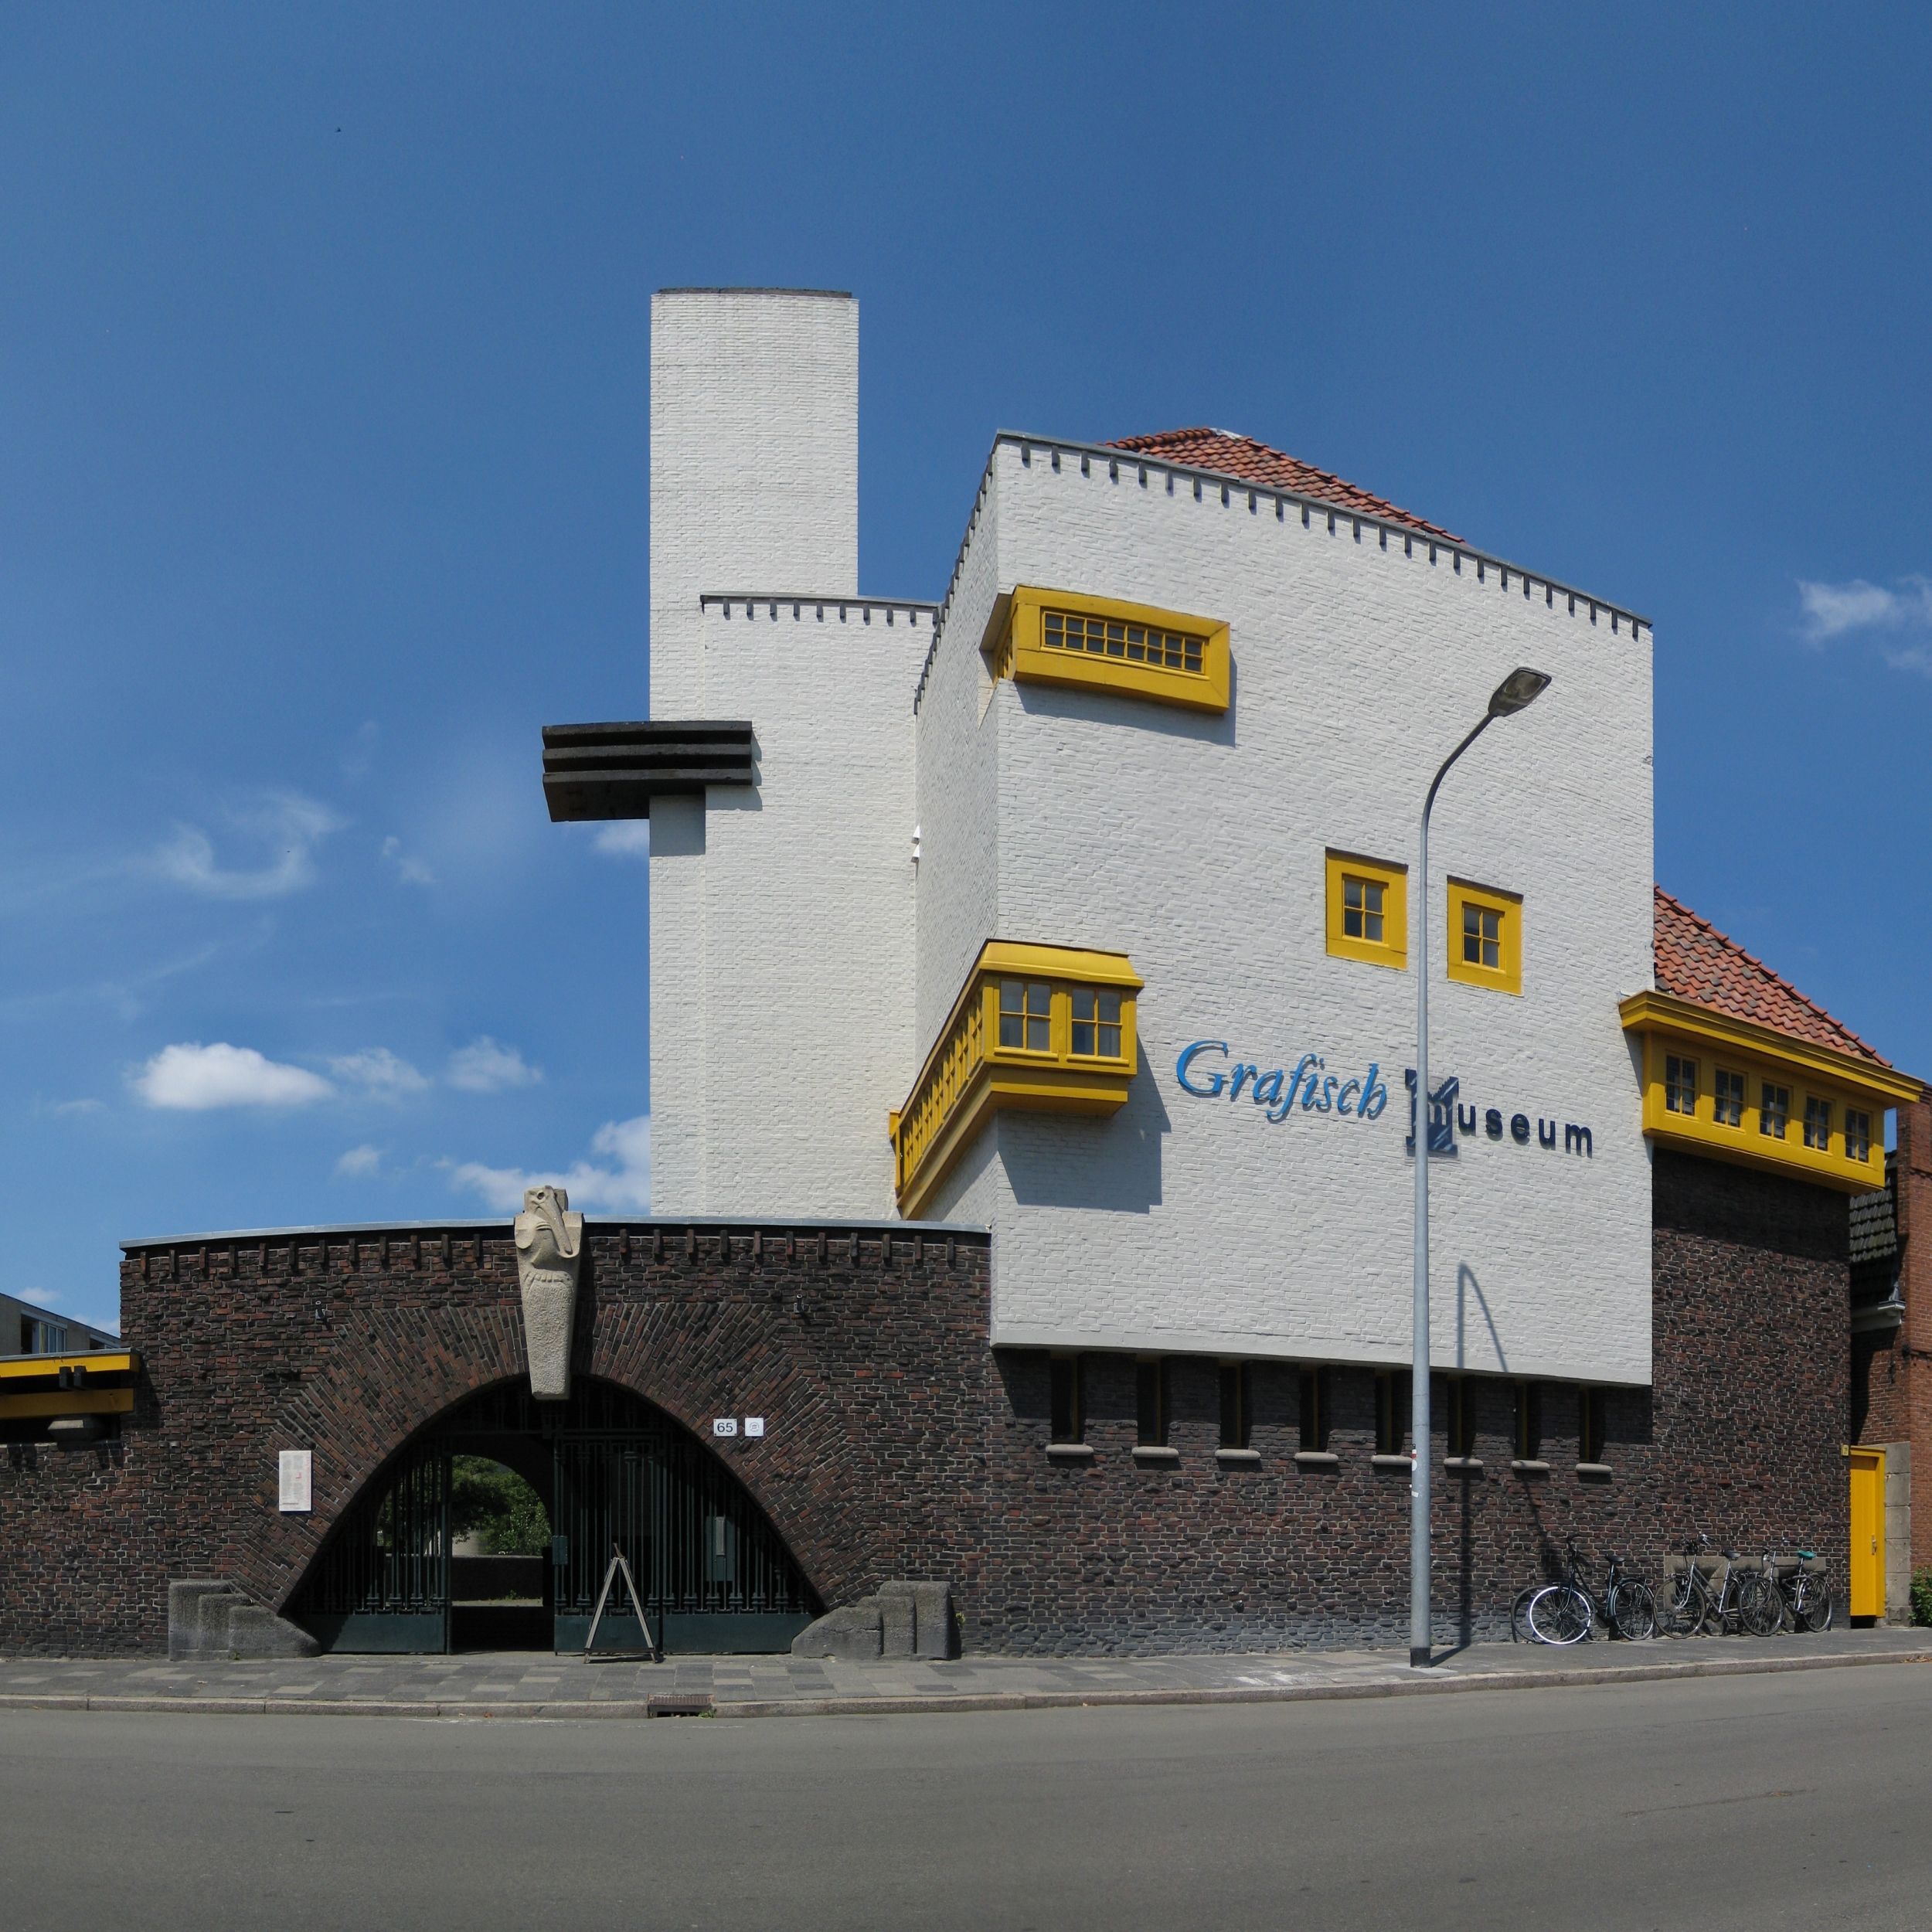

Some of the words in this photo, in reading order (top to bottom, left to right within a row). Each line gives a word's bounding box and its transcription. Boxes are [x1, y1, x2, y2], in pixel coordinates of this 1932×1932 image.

[1175, 1039, 1387, 1120] Grafisch
[1404, 1068, 1593, 1157] Museum
[717, 1422, 733, 1433] 65
